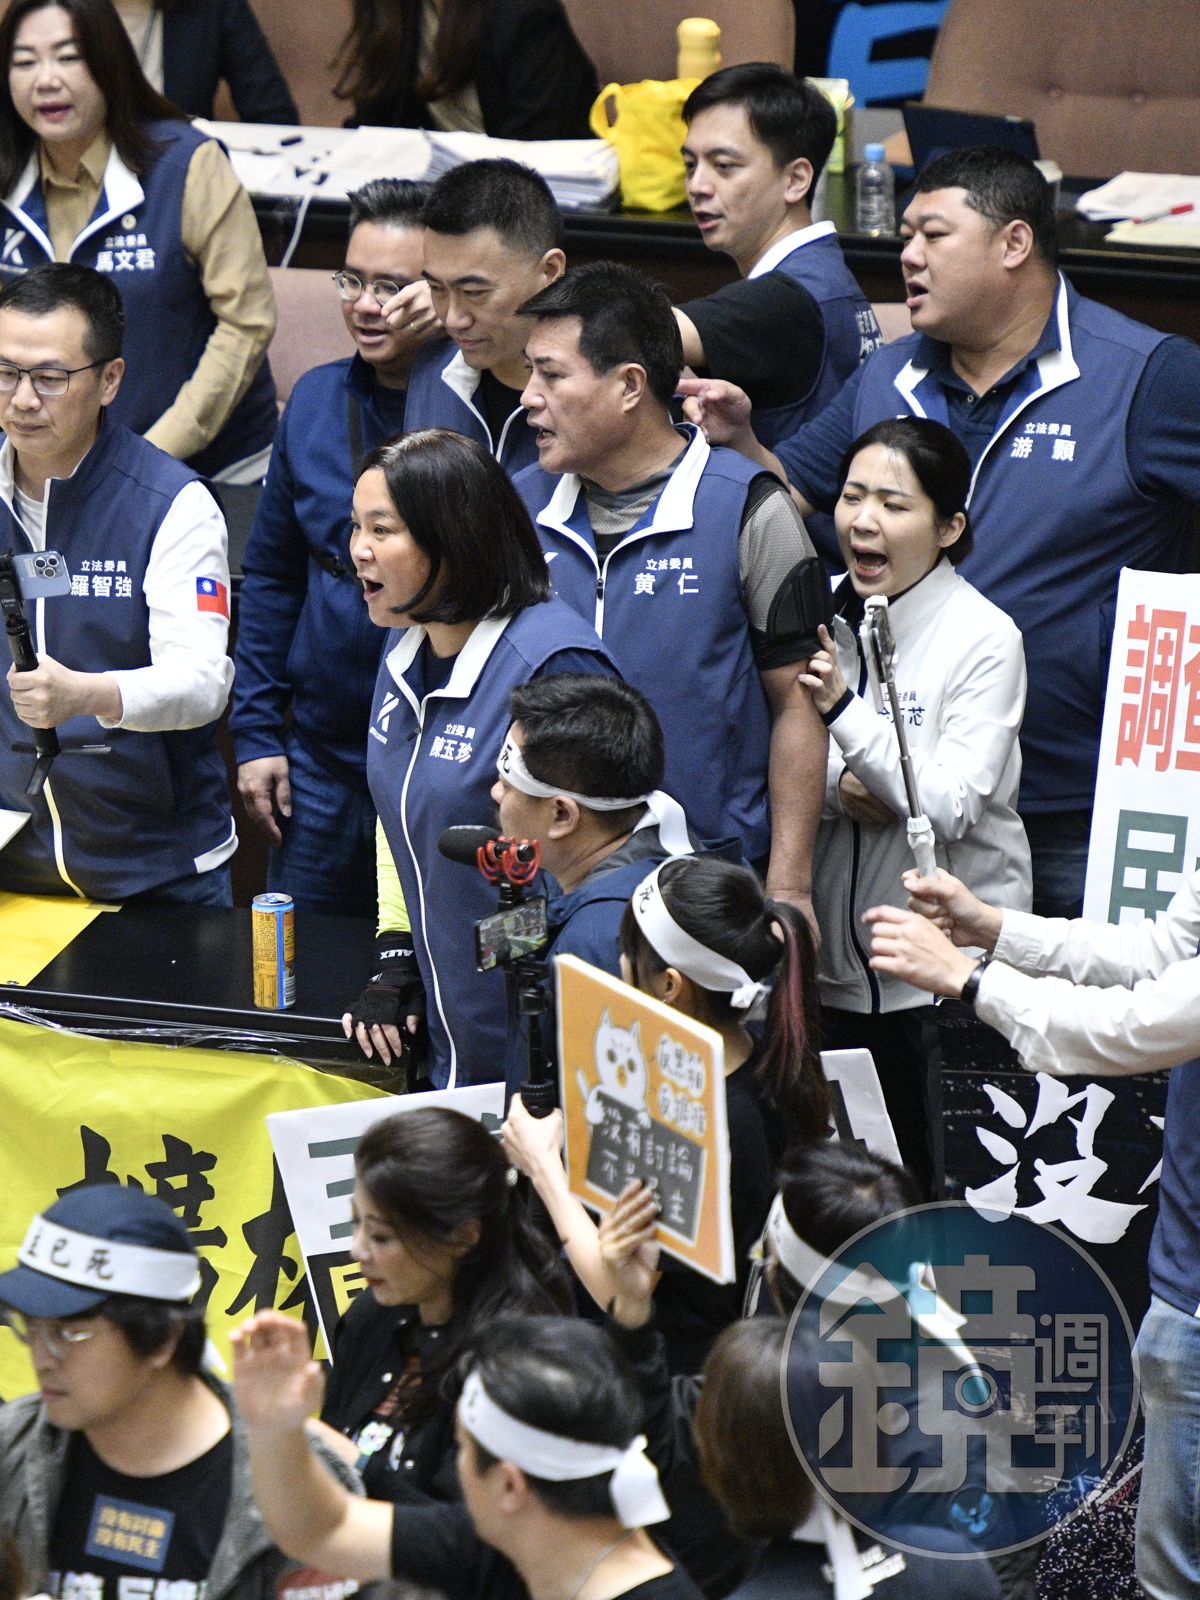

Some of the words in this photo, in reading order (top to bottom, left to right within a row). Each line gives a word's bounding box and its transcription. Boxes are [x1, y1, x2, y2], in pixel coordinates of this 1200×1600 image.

[95, 248, 155, 272] 馬文君
[1024, 422, 1072, 437] 立法委員
[80, 560, 127, 573] 立法委員
[645, 557, 693, 571] 立法委員
[71, 574, 132, 598] 羅智強
[429, 736, 473, 763] 陳玉珍
[964, 1071, 1166, 1245] 沒
